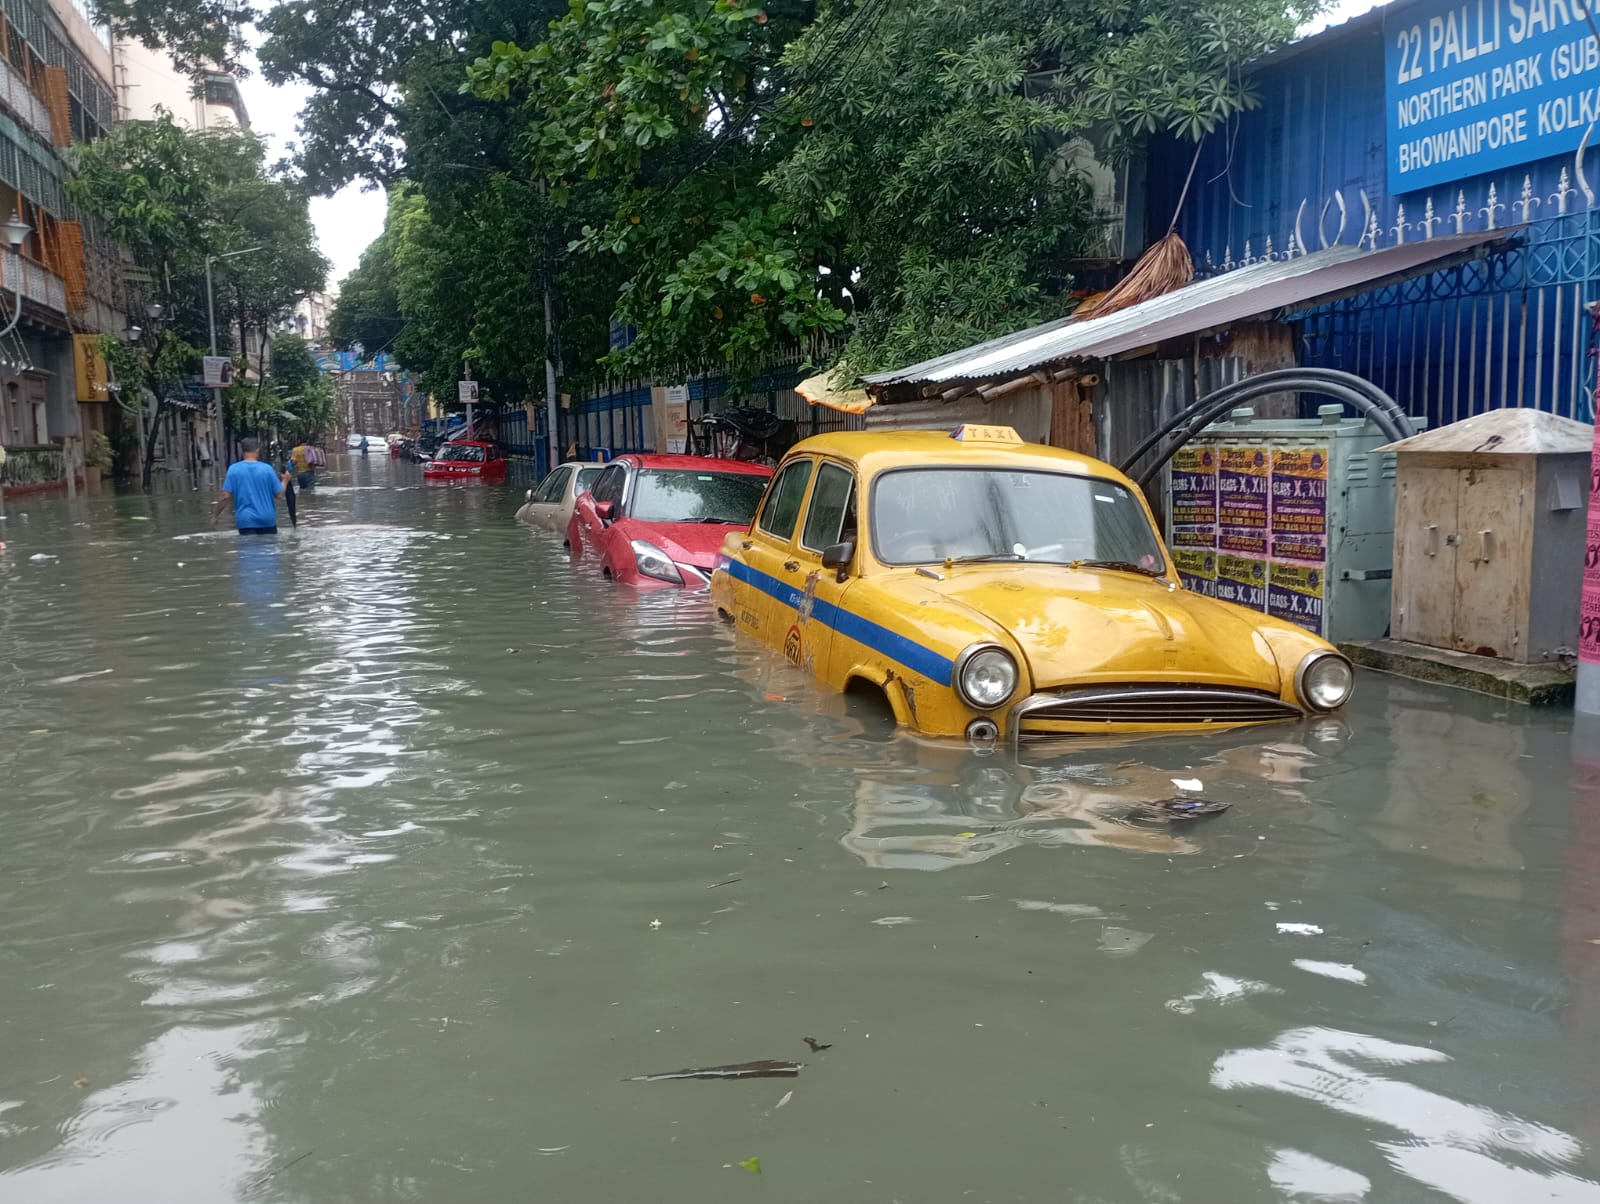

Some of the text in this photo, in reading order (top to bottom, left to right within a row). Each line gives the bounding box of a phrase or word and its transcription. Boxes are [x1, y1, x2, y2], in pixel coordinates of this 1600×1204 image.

[1397, 0, 1600, 85] 22 PALLI SAR
[1398, 72, 1487, 130] NORTHERN
[1491, 53, 1543, 100] PARK
[1399, 108, 1528, 174] BHOWANIPORE
[968, 428, 1014, 440] TAXI
[1305, 598, 1322, 617] XII
